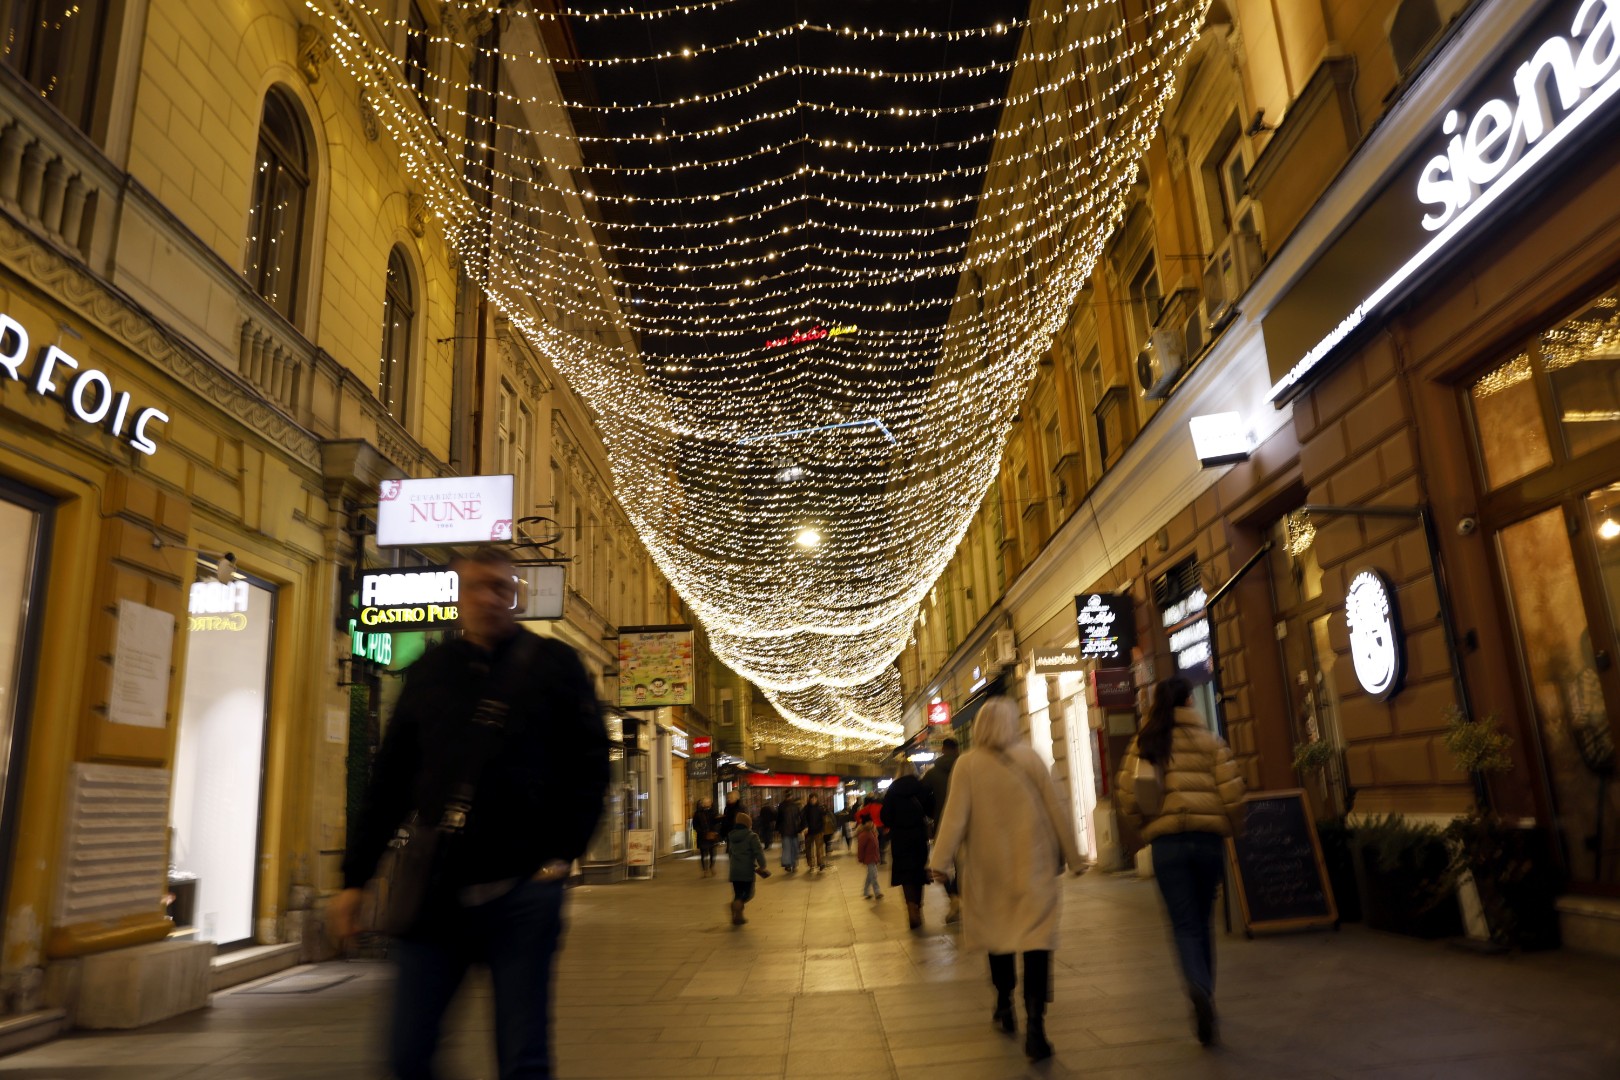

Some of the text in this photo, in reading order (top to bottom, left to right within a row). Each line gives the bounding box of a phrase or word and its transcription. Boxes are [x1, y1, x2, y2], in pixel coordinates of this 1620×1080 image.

[1417, 0, 1620, 232] siena
[0, 313, 169, 456] RFOIS
[408, 500, 482, 523] NUNE
[428, 605, 459, 622] PUB
